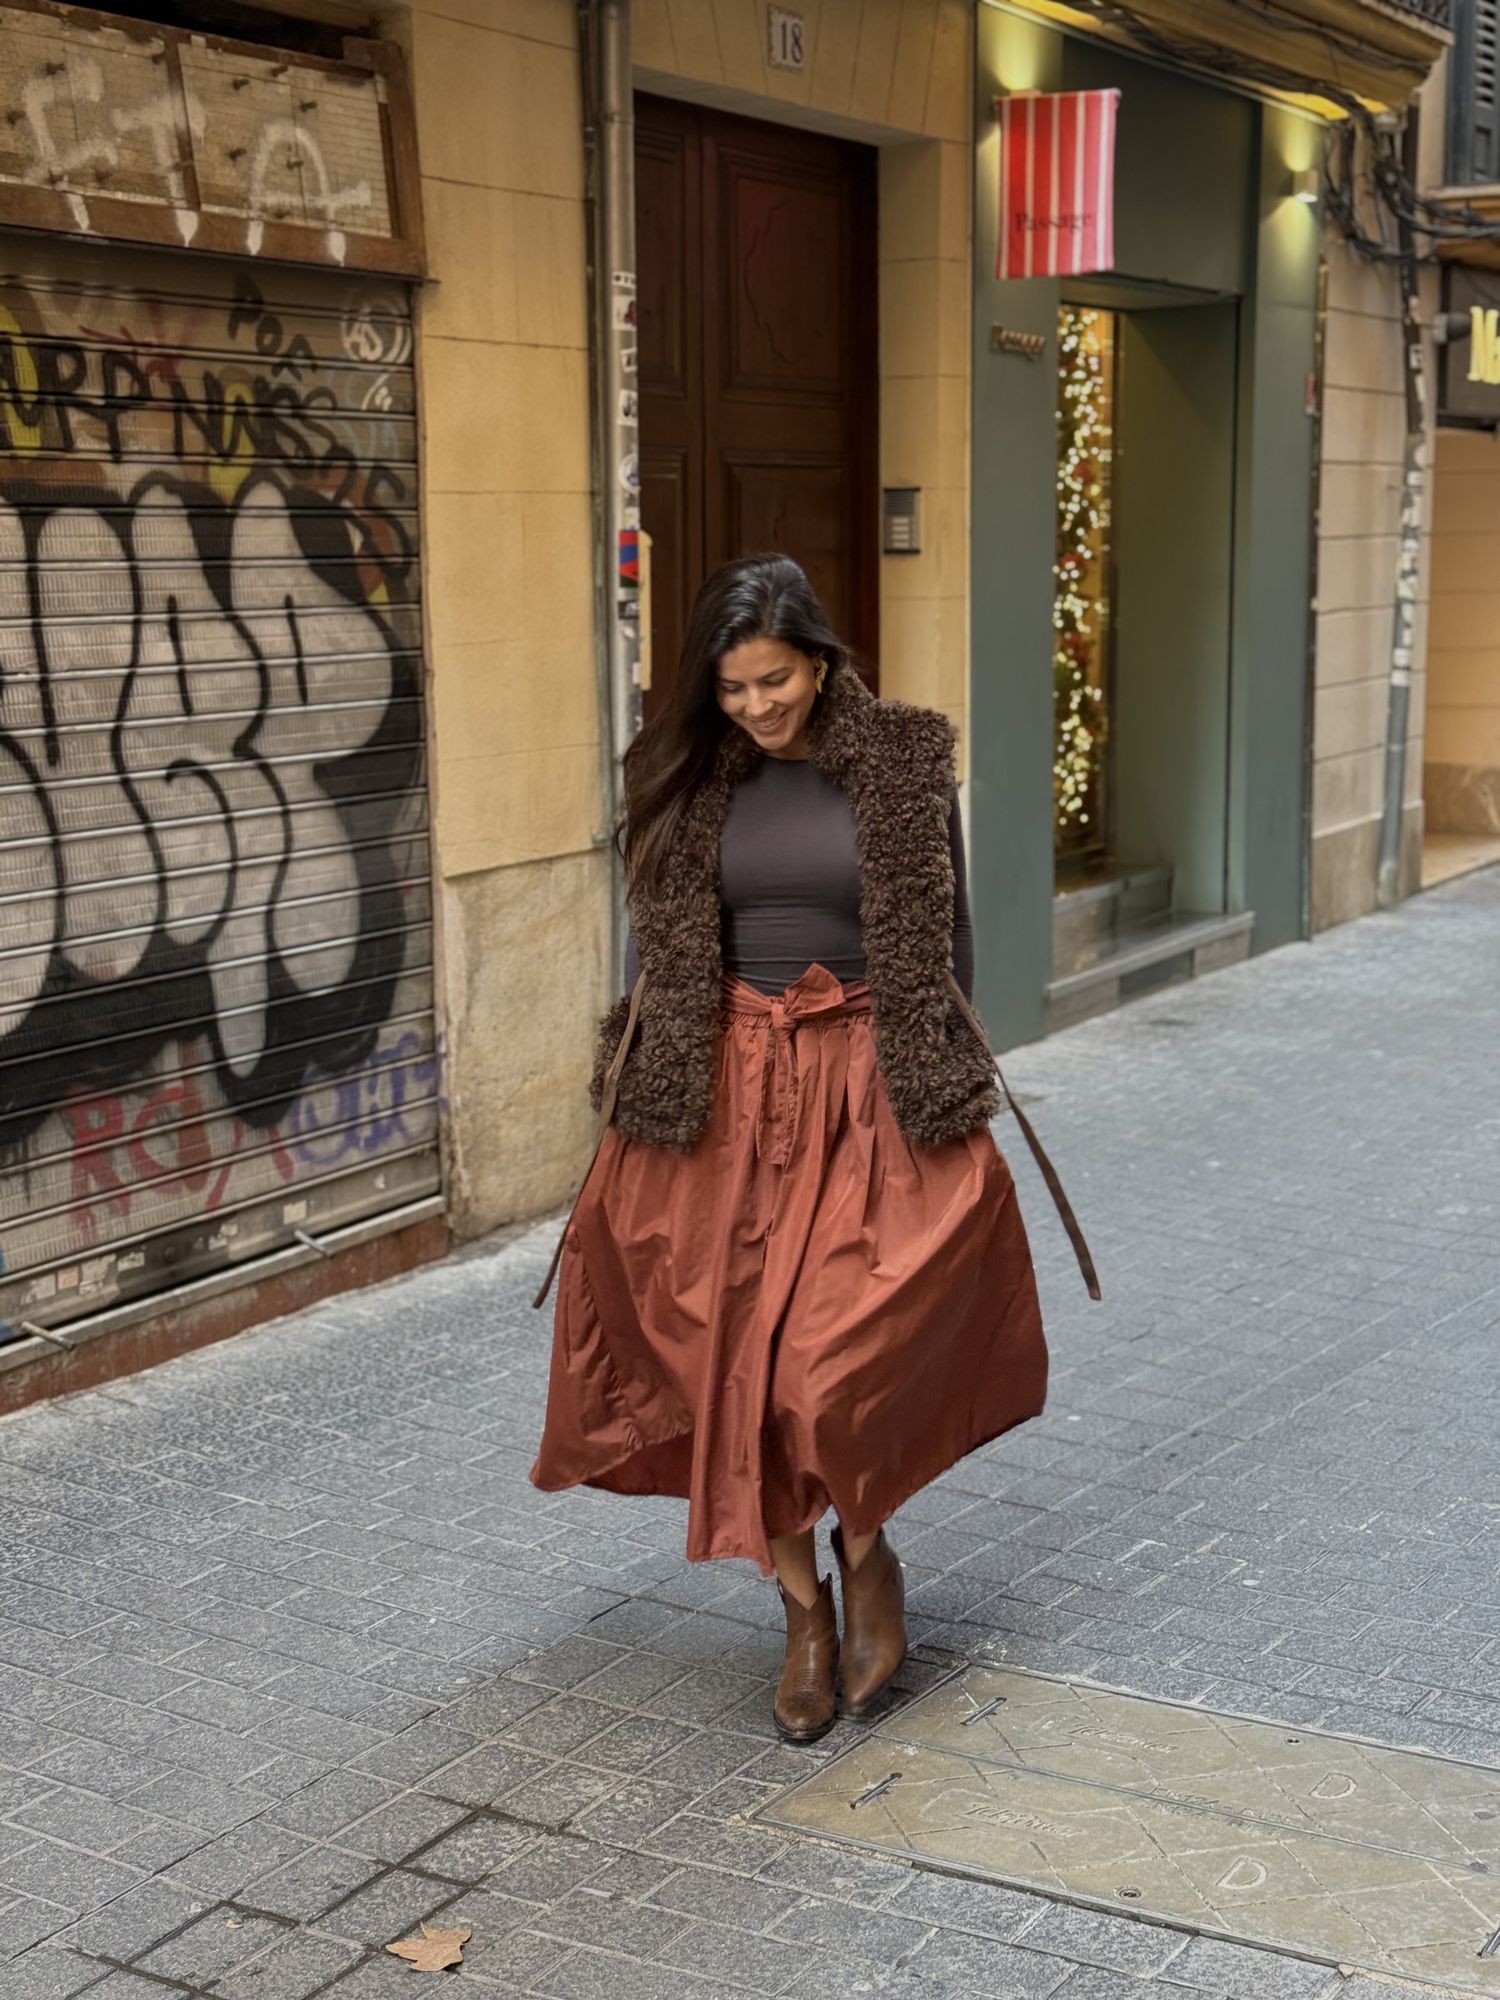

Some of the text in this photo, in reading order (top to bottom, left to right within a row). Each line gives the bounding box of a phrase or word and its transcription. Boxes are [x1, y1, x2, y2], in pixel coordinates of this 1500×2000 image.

[781, 21, 804, 64] 18
[1015, 211, 1094, 236] Passage
[1308, 1769, 1359, 1799] D
[1215, 1855, 1267, 1890] D
